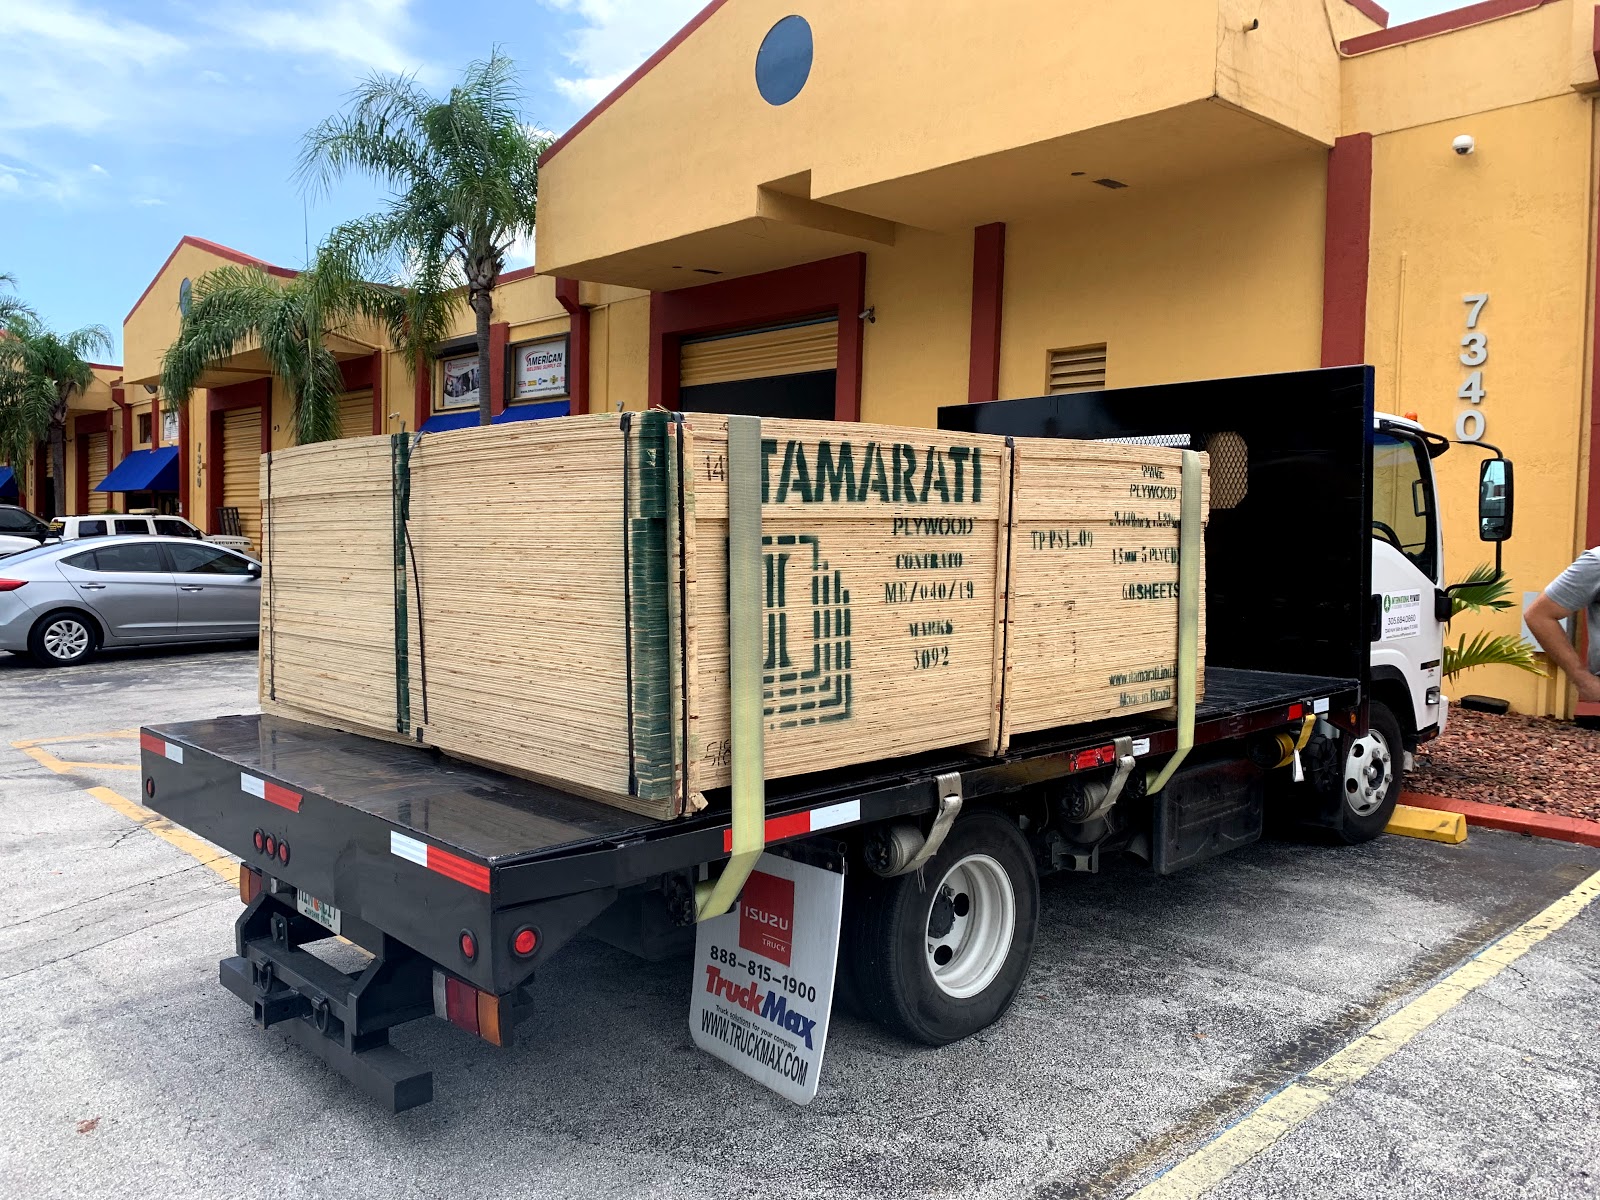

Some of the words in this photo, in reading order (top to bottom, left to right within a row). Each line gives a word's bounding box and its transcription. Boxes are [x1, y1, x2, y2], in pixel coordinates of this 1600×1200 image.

[526, 352, 563, 366] AMERICAN
[1455, 293, 1489, 442] 7340
[1141, 465, 1165, 479] PINE
[1130, 483, 1177, 500] PLYWOOD
[892, 517, 974, 536] PLYWOOD
[895, 552, 963, 569] CONTRATO
[884, 579, 974, 603] ME/040/19
[913, 646, 949, 670] 3092
[1150, 686, 1171, 702] Brazil
[745, 905, 789, 931] ISUZU
[762, 938, 786, 953] TRUCK
[710, 945, 816, 1003] 888-815-1900
[705, 964, 817, 1051] TruckMax
[716, 1004, 729, 1017] Truck
[729, 1011, 751, 1029] solutions
[752, 1022, 760, 1032] for
[761, 1029, 774, 1039] your
[773, 1034, 798, 1053] company
[701, 1008, 809, 1087] WWW.TRUCKMAX.COM
